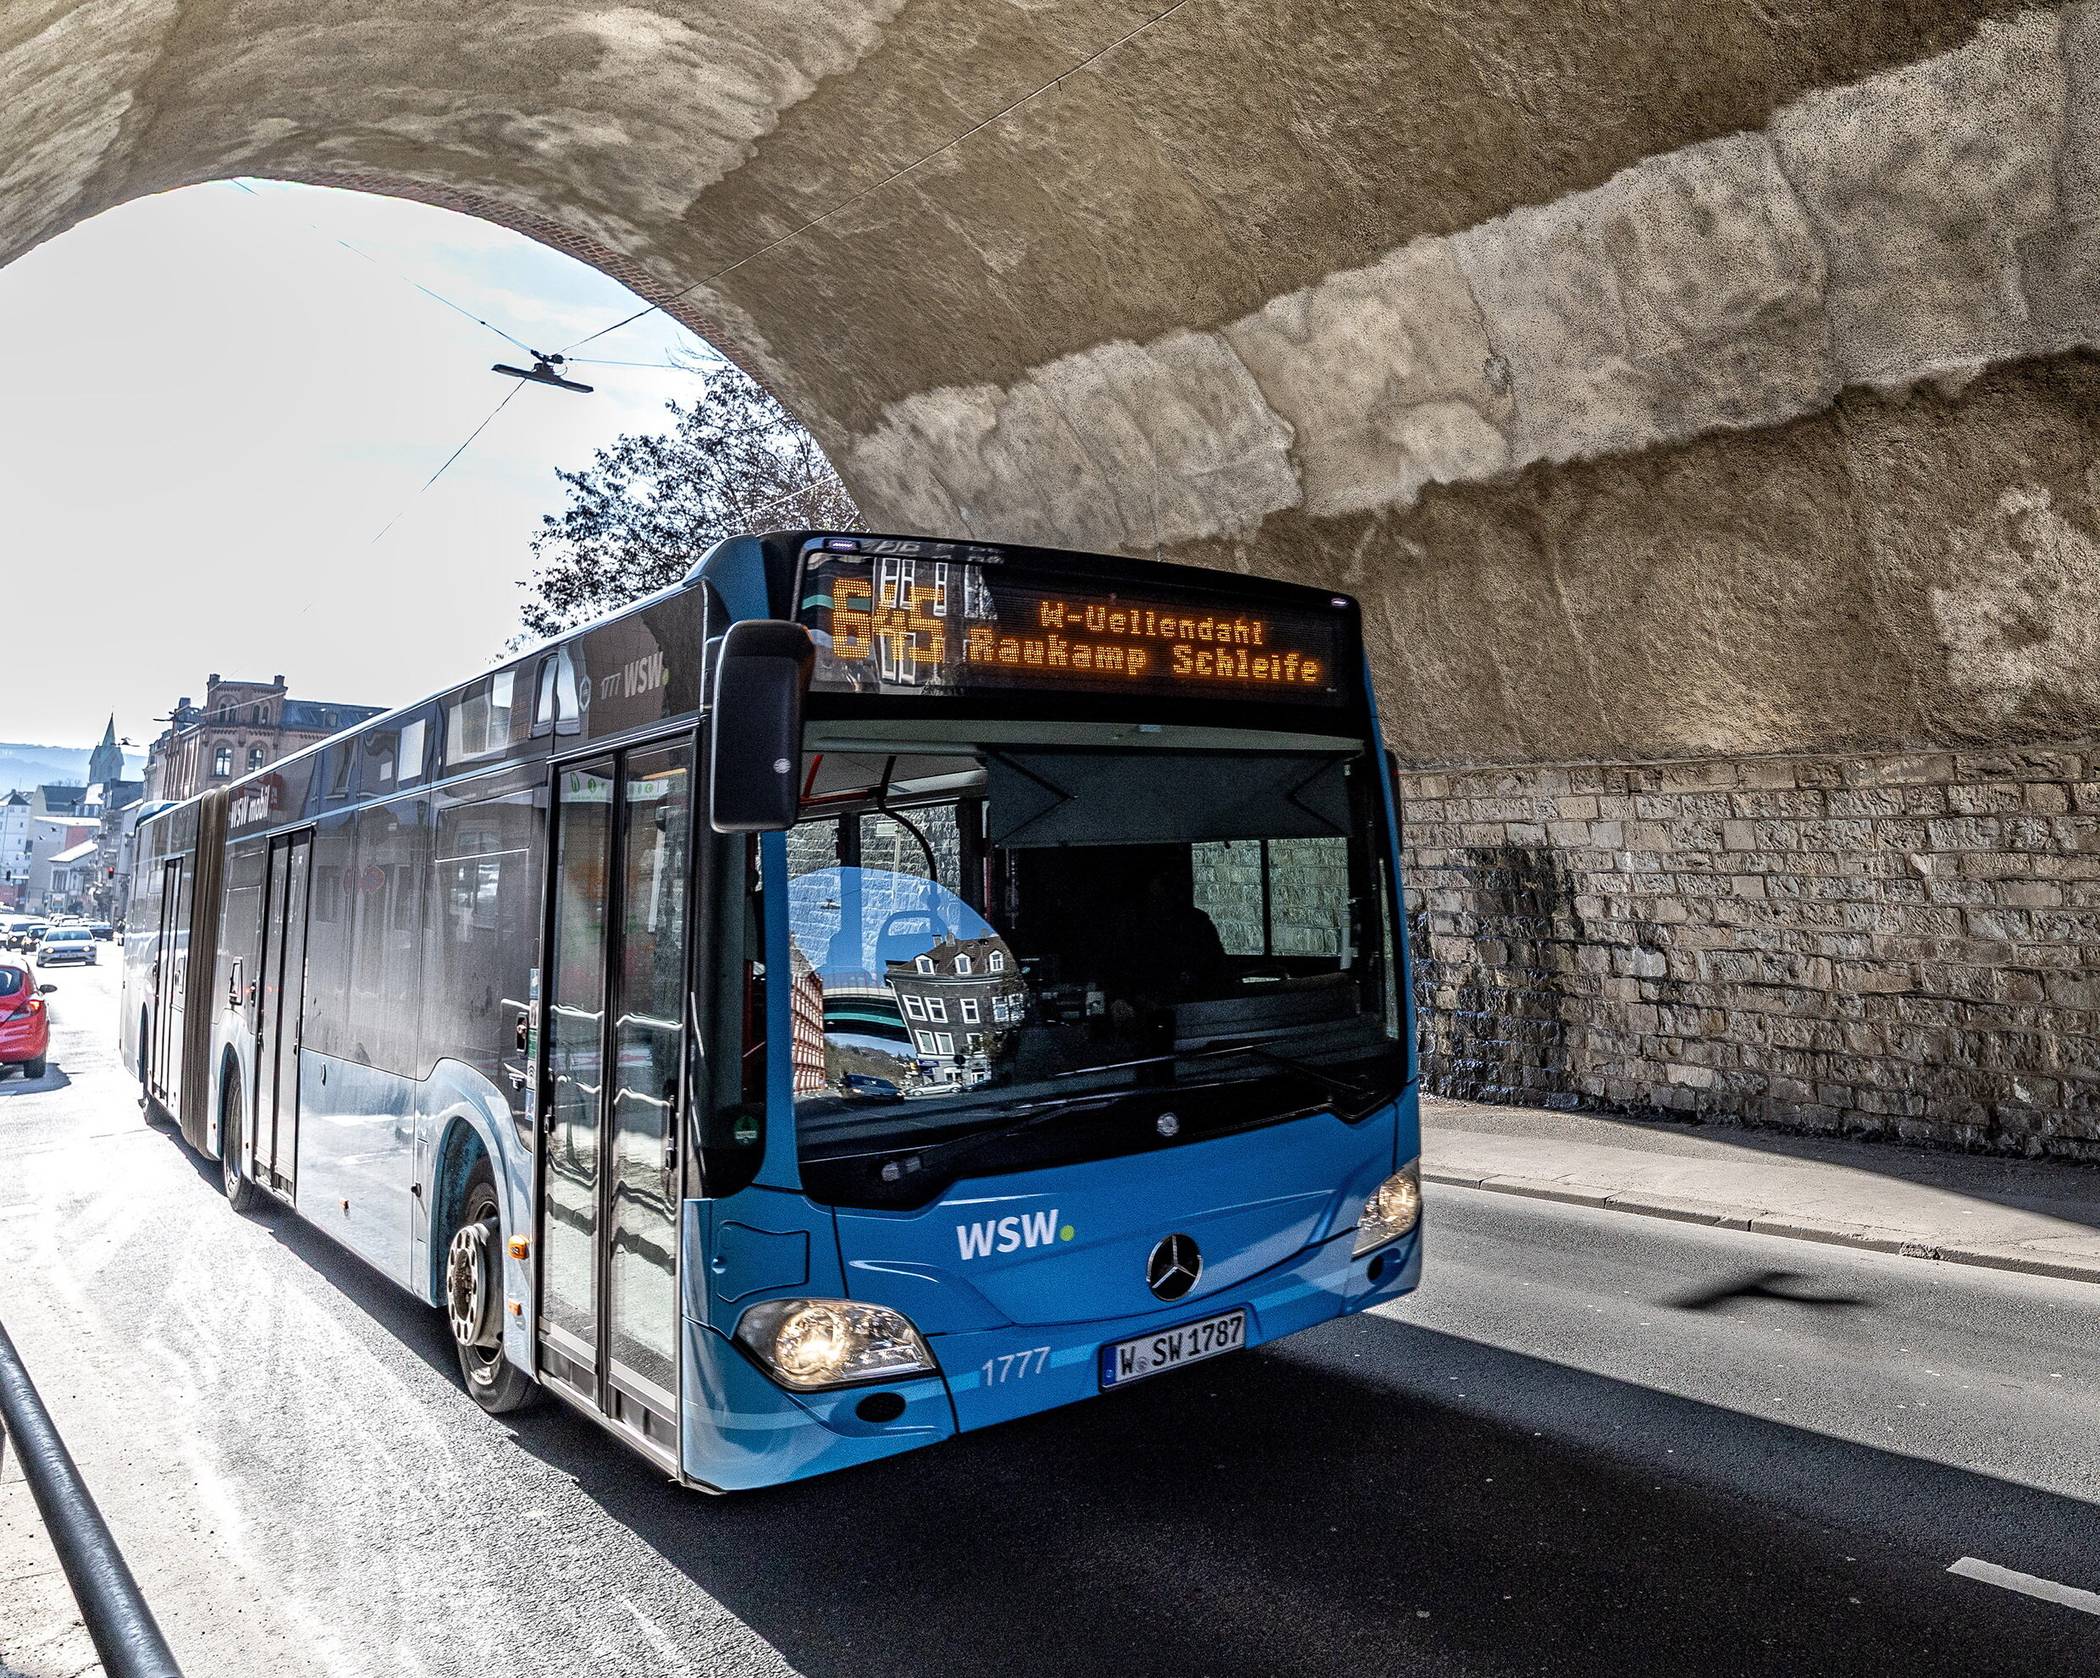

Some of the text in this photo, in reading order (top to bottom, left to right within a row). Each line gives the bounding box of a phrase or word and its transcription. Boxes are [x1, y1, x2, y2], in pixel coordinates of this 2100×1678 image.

[833, 579, 944, 663] 645
[1040, 601, 1263, 645] W-Uellendahl
[969, 628, 1319, 682] Raukamp Schleife
[230, 784, 271, 829] WSW mobil
[981, 1346, 1051, 1386] 1777
